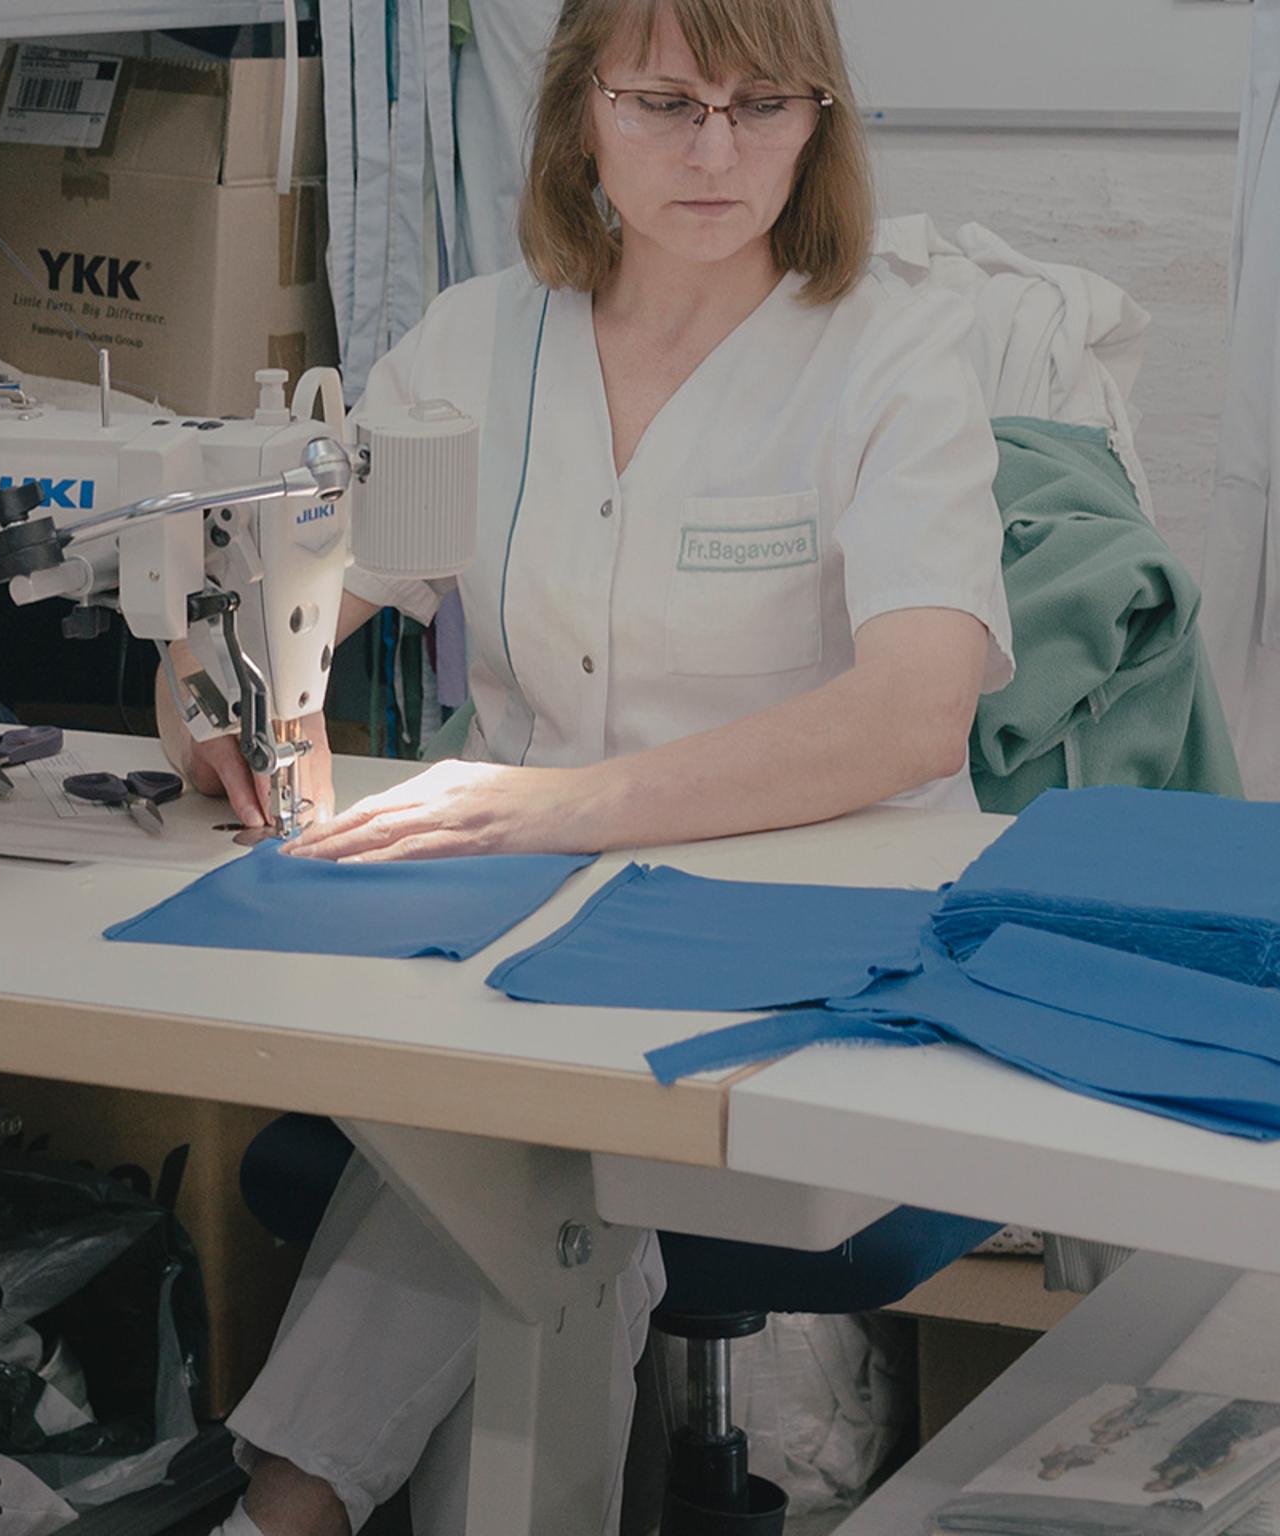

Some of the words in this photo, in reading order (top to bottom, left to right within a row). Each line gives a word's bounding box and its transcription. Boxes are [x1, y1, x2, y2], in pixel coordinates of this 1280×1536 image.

[37, 248, 142, 301] YKK
[81, 303, 100, 319] Big
[115, 335, 143, 349] Group
[686, 536, 808, 564] Fr.Bagavova
